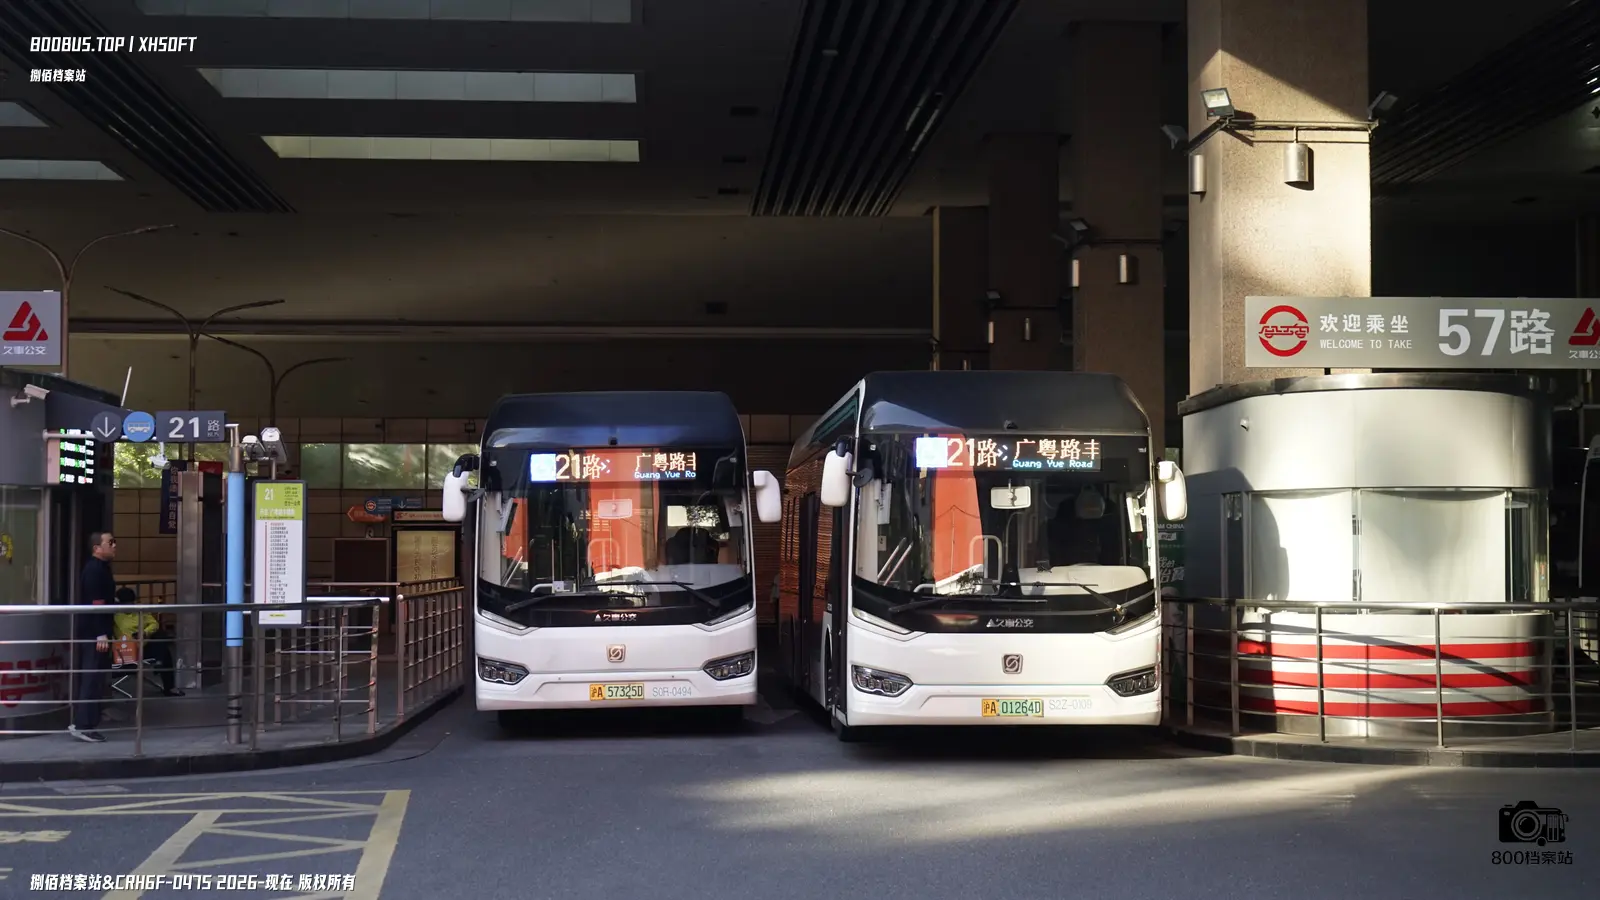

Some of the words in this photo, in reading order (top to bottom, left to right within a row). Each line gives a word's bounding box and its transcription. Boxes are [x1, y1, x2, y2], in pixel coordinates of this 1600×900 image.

[1319, 313, 1410, 335] 欢迎乘坐
[1438, 308, 1555, 356] 57路
[1319, 338, 1364, 350] WELCOME
[1369, 338, 1382, 350] TO
[1388, 338, 1412, 350] TAKE
[168, 416, 200, 439] 21
[947, 437, 998, 468] 21路
[555, 453, 601, 480] 21路
[634, 470, 661, 480] Guang
[665, 470, 681, 479] Yue
[685, 470, 697, 479] Ro
[1012, 459, 1042, 469] Guang
[1047, 459, 1065, 468] Yue
[1069, 459, 1093, 468] Road
